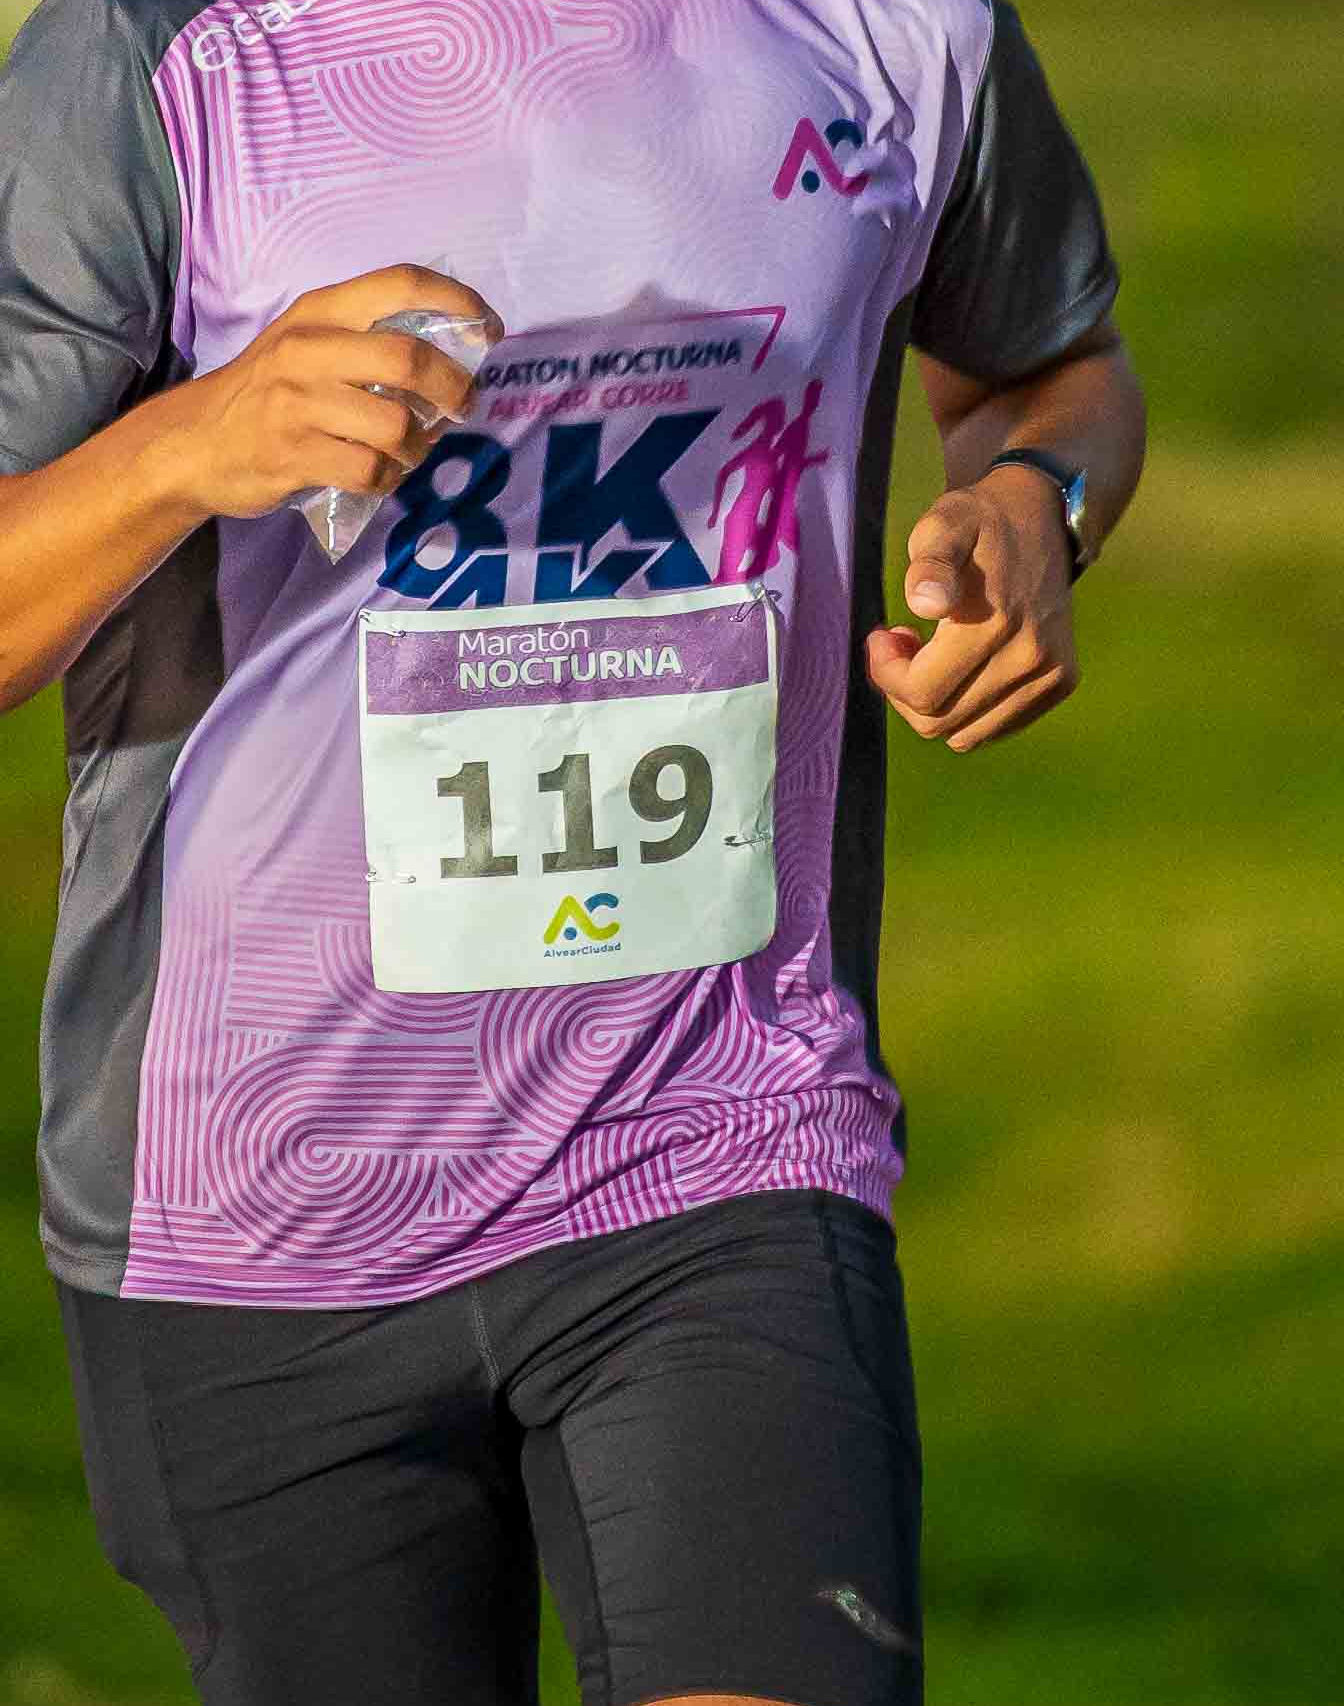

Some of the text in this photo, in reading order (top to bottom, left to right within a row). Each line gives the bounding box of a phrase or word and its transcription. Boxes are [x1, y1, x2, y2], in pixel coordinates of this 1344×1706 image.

[473, 340, 744, 391] ARATON NOCTURNA
[376, 406, 724, 600] 8K
[458, 622, 589, 658] Maratón
[458, 645, 683, 690] NOCTURNA
[437, 744, 713, 879] 119
[543, 942, 622, 958] AlvearCiudad
